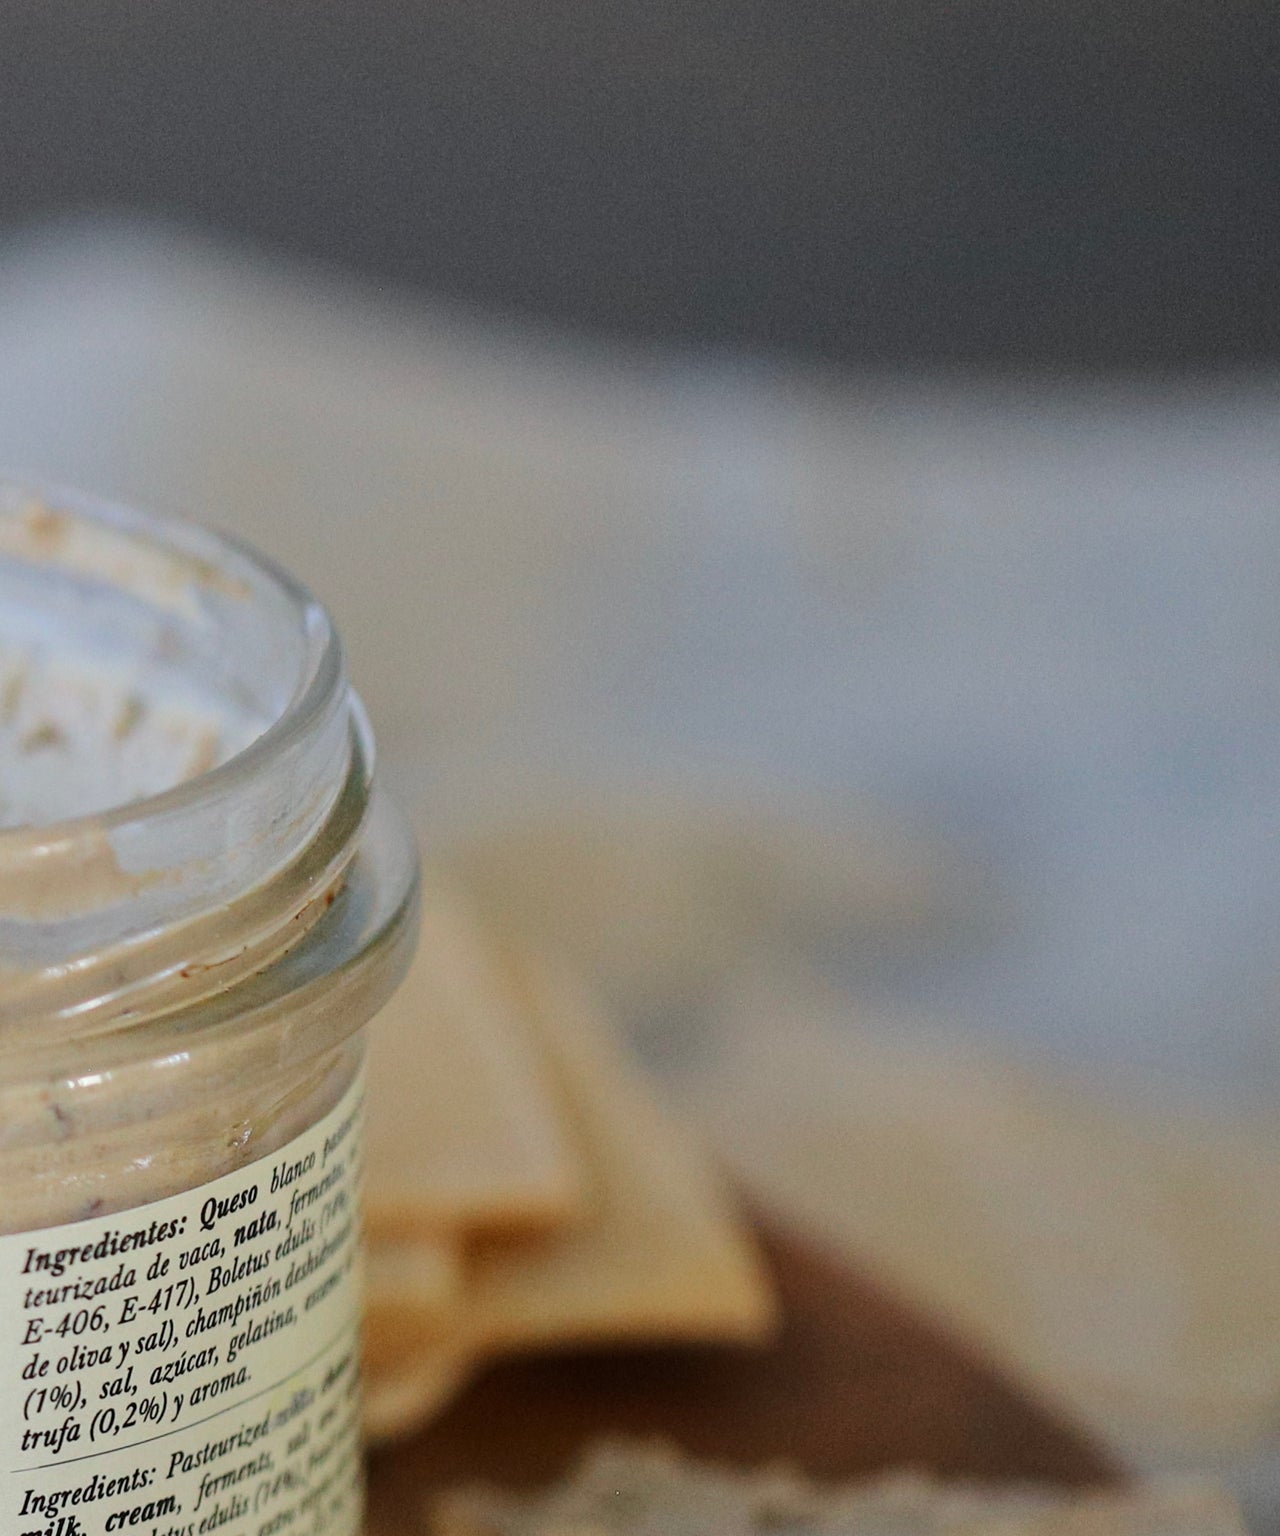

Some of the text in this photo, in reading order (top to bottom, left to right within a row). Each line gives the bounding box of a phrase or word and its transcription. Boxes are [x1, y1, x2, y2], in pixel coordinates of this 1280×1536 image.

[21, 1152, 316, 1277] Ingredientes: Queso blanco
[24, 1264, 137, 1310] teurizada
[146, 1254, 170, 1282] de
[179, 1237, 227, 1272] vaca,
[234, 1209, 282, 1248] nata,
[21, 1304, 111, 1347] E-406,
[119, 1280, 200, 1325] E-417),
[206, 1251, 271, 1296] Boletus
[275, 1218, 316, 1262] edulis
[22, 1352, 50, 1382] de
[56, 1335, 113, 1373] oliva
[116, 1340, 131, 1370] y
[134, 1317, 180, 1356] sal),
[184, 1282, 282, 1341] champiñón
[20, 1418, 81, 1455] trufa
[89, 1391, 170, 1442] (0,2%)
[171, 1394, 186, 1422] y
[189, 1364, 252, 1407] aroma.
[23, 1305, 298, 1421] (1%), sal, azúcar, gelatina,
[18, 1467, 157, 1518] Ingredients:
[166, 1408, 271, 1480] Pasteurized
[104, 1493, 183, 1534] cream,
[193, 1450, 275, 1513] ferments,
[198, 1494, 249, 1536] edulis
